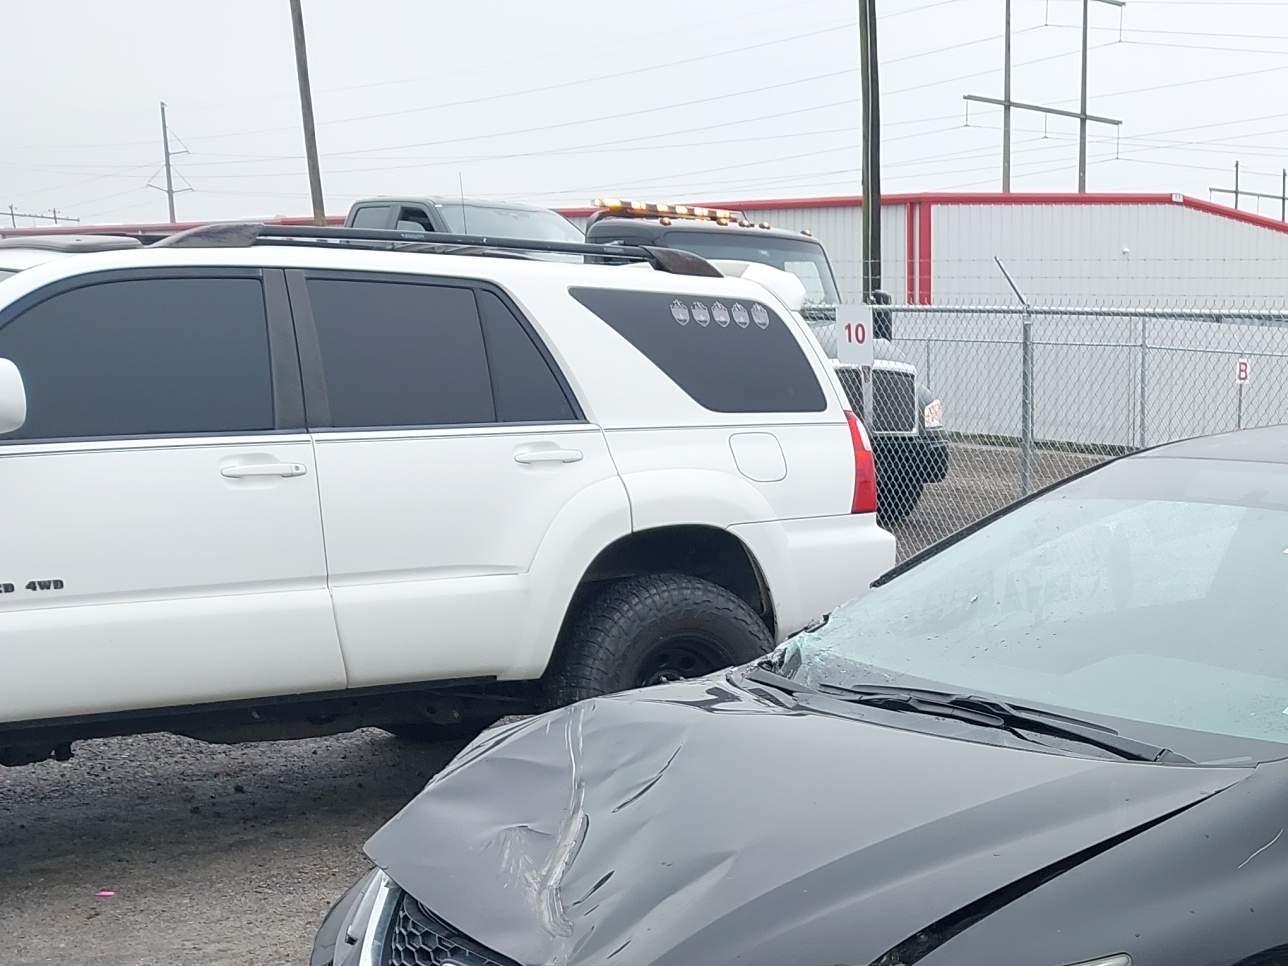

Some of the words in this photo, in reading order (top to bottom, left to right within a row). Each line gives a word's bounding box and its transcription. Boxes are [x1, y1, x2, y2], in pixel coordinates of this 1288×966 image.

[844, 323, 865, 344] 10
[1237, 362, 1248, 380] B
[25, 579, 64, 591] 4WD
